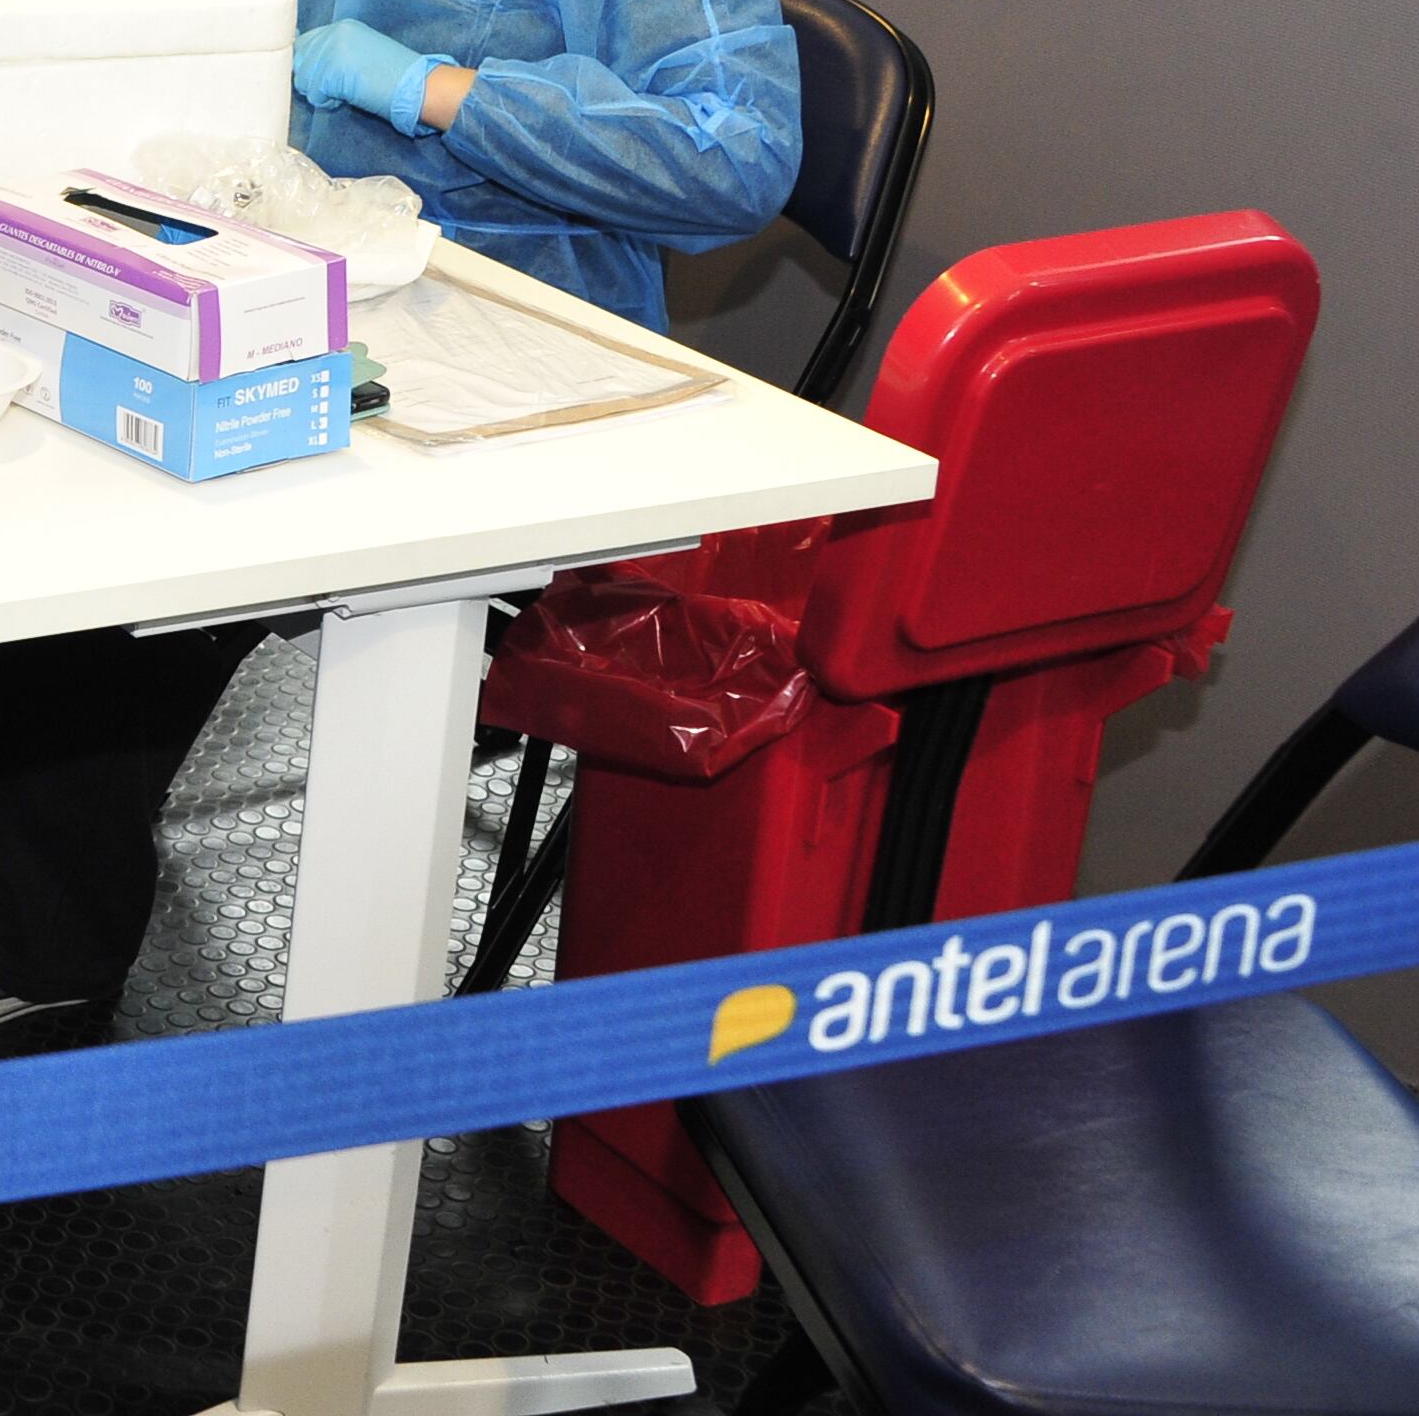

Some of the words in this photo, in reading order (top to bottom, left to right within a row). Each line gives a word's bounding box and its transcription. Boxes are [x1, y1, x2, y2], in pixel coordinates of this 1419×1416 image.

[262, 337, 304, 356] MEDIANO
[133, 376, 153, 394] 100
[234, 376, 300, 406] SKYMED
[808, 919, 1052, 1053] antel
[1057, 893, 1317, 1010] arena
